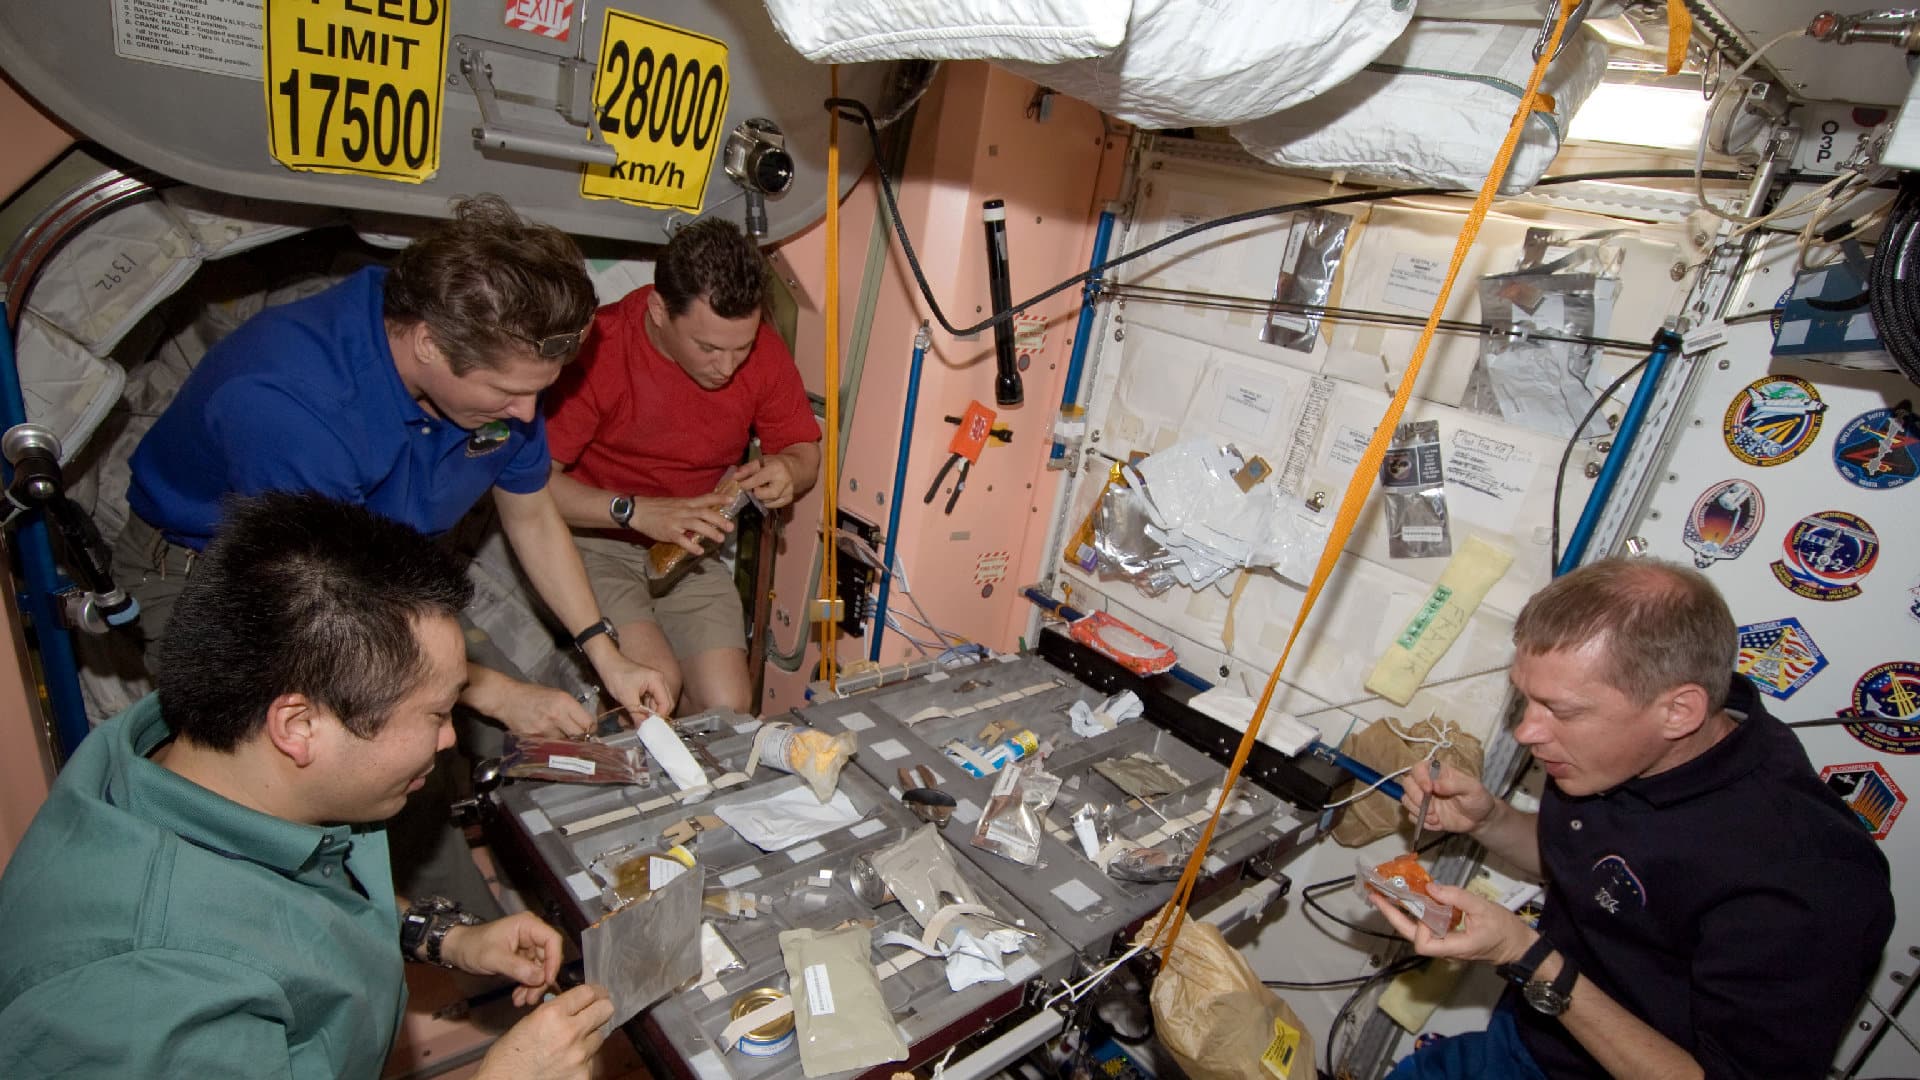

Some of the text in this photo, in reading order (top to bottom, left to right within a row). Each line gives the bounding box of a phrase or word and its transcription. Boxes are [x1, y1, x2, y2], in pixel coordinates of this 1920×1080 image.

[516, 0, 564, 24] EXIT
[297, 17, 420, 70] LIMIT
[599, 40, 723, 151] 28000
[280, 68, 430, 170] 17500
[609, 154, 686, 189] km/h
[1863, 663, 1903, 683] HOROWITZ
